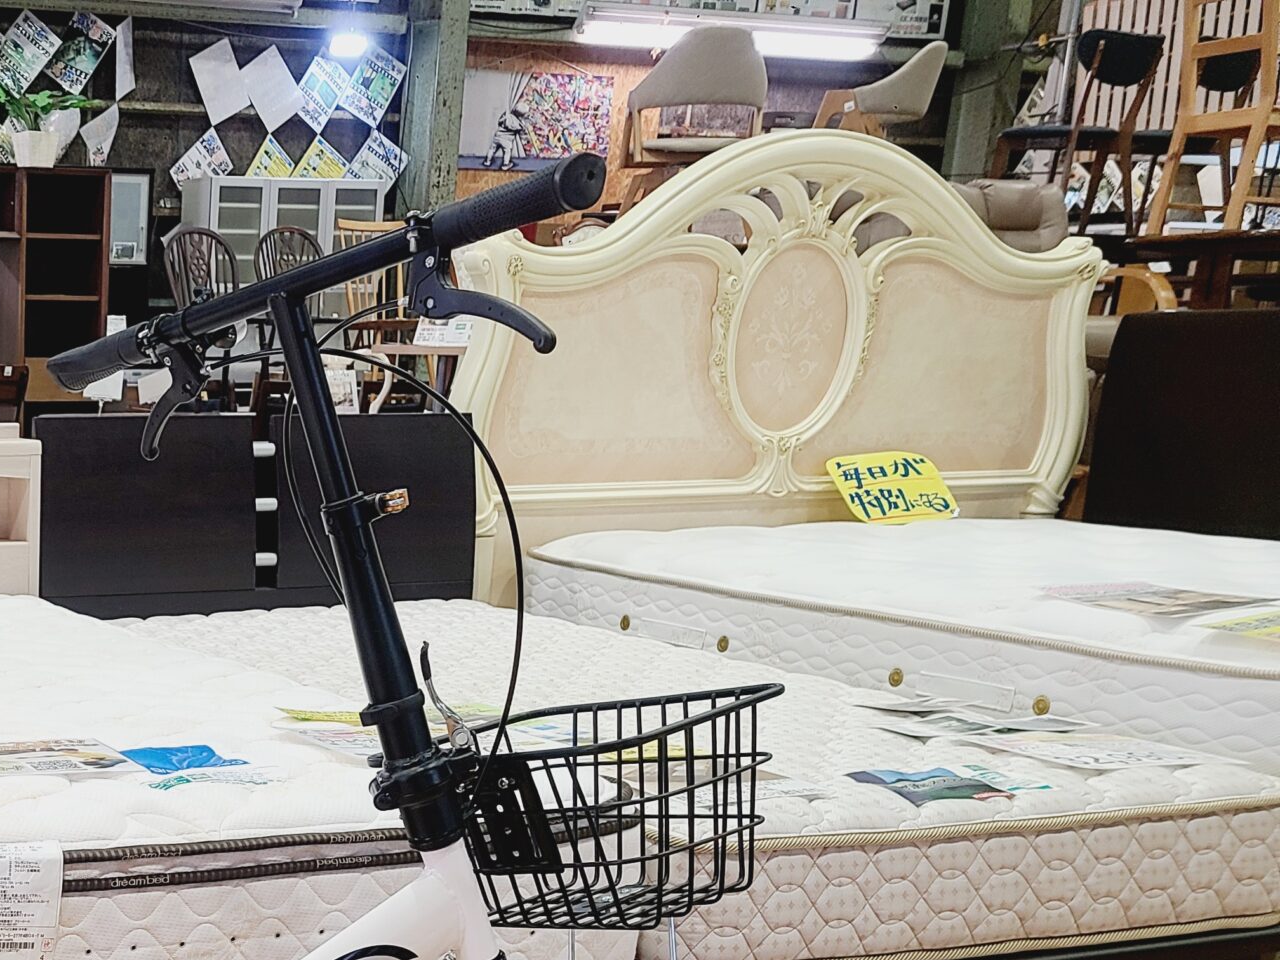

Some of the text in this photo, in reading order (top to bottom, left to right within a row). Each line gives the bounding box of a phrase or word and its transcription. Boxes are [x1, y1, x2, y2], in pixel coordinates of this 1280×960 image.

[835, 457, 926, 489] 毎日が
[848, 488, 950, 519] 特別になる
[110, 874, 170, 888] dreambed
